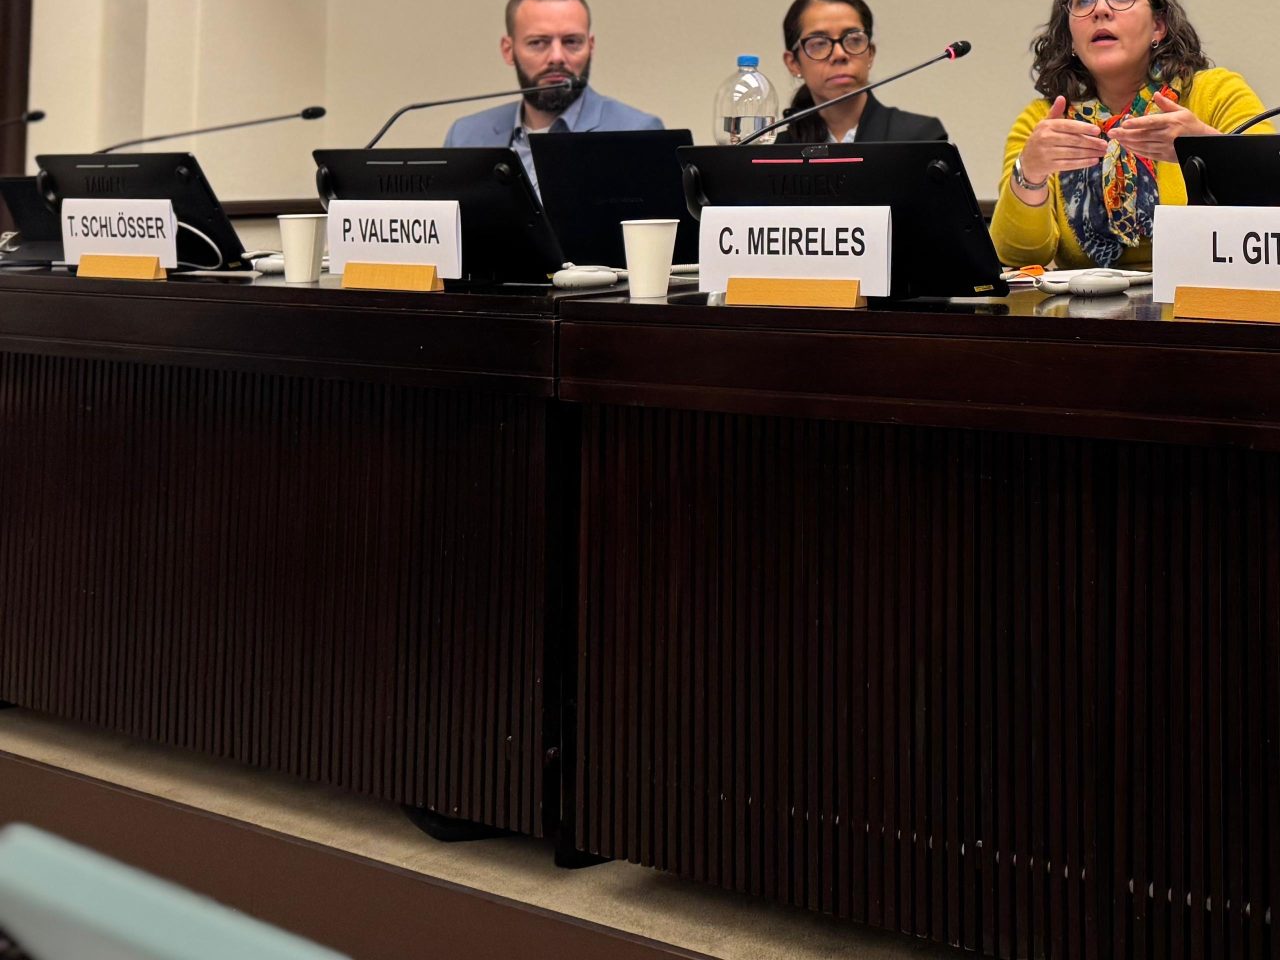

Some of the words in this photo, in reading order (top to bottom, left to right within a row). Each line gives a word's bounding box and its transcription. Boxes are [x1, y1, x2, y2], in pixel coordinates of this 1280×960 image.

[67, 215, 78, 237] T.
[81, 212, 166, 239] SCHLÖSSER
[342, 218, 355, 242] P.
[359, 218, 440, 245] VALENCIA
[718, 226, 740, 255] C.
[747, 226, 866, 257] MEIRELES
[1212, 231, 1233, 263] L.
